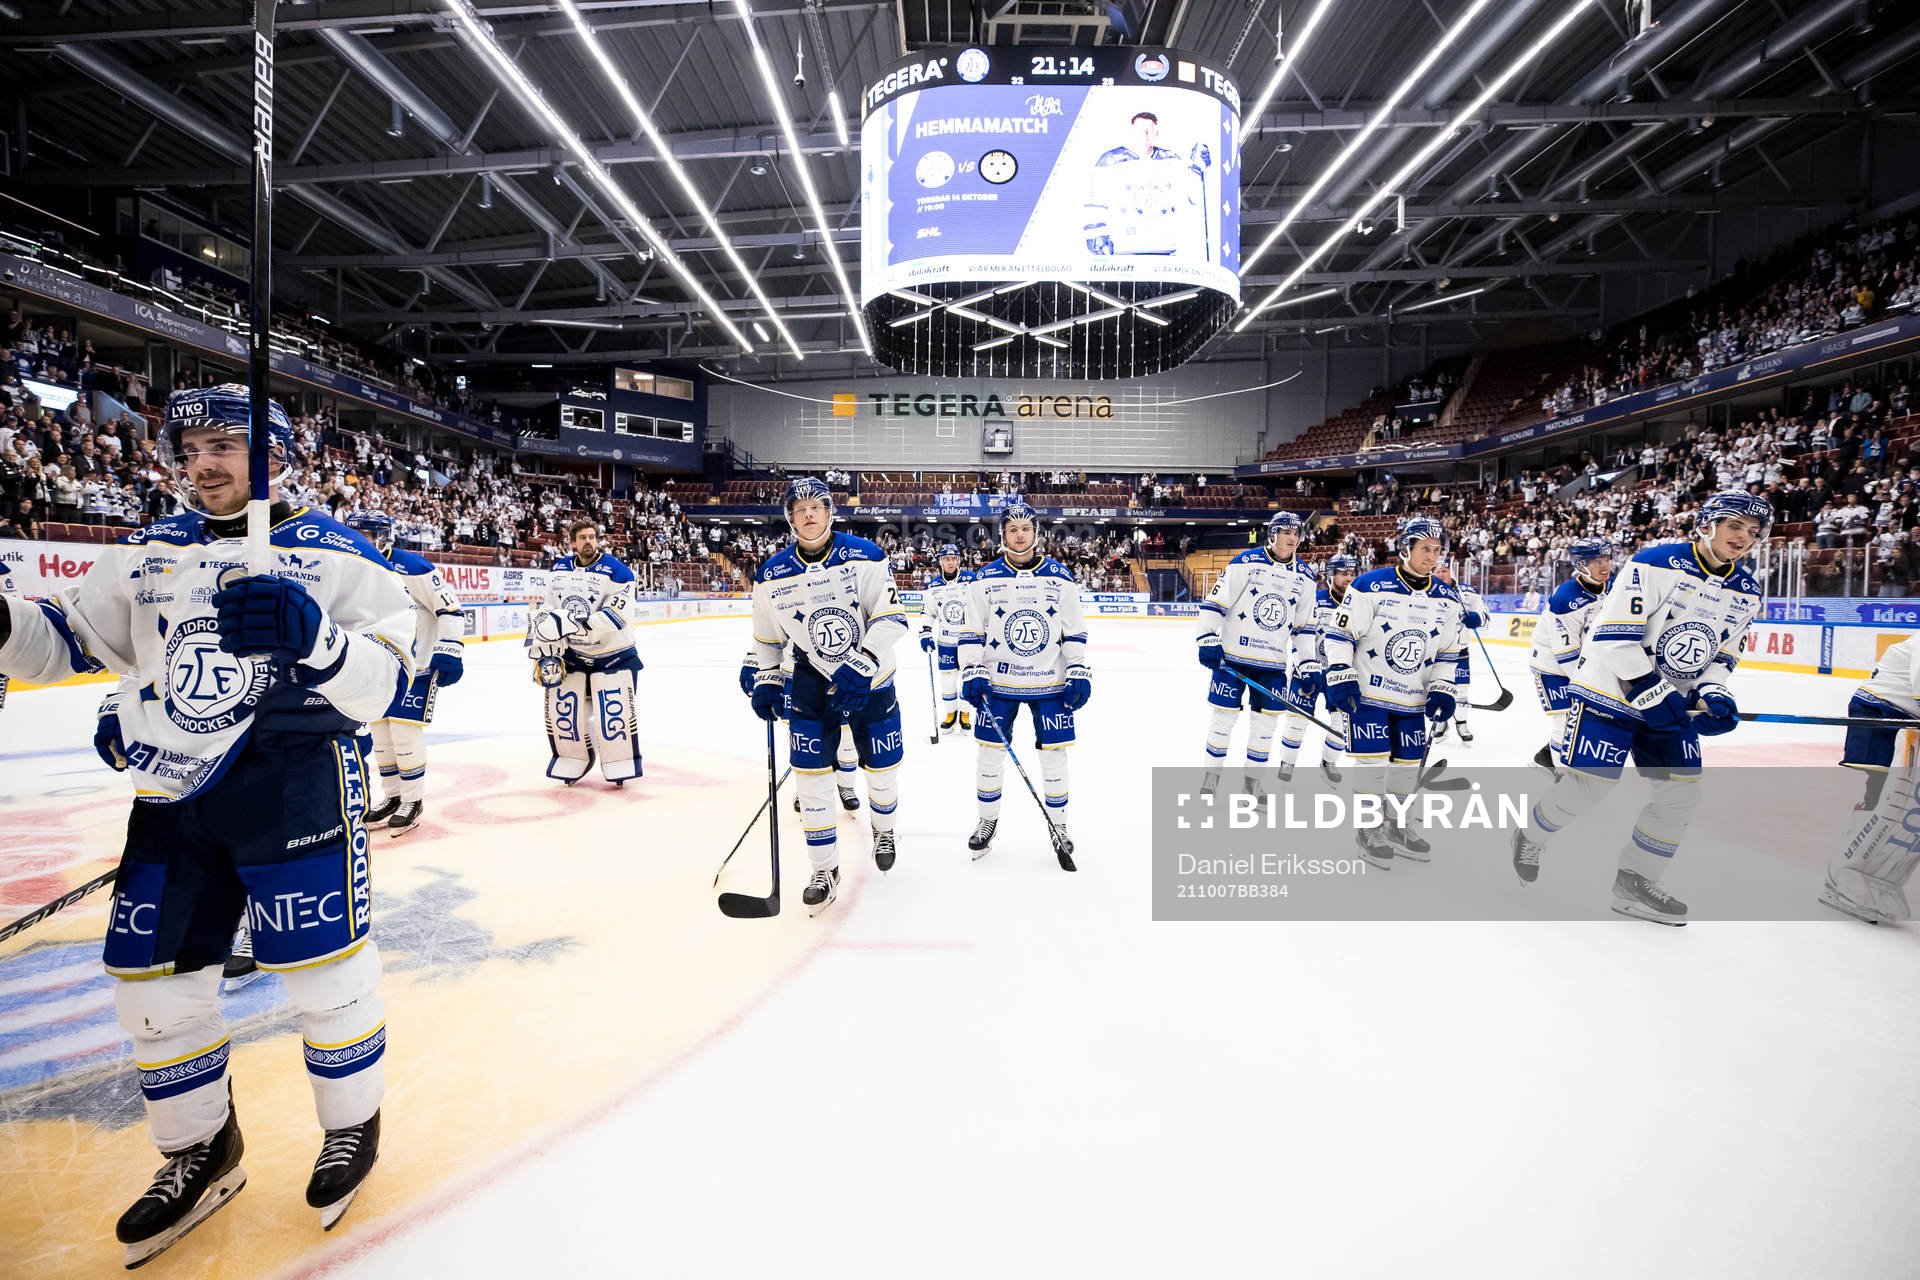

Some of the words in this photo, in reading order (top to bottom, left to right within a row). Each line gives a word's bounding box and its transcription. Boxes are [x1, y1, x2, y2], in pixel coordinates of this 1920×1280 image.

[1032, 57, 1095, 75] 21:14
[916, 117, 1048, 138] HEMMAMATCH
[961, 193, 998, 201] OKTOBER
[908, 264, 950, 277] dalakraft
[1089, 263, 1135, 273] dalakraft
[134, 303, 155, 321] ICA
[172, 403, 204, 418] LYKO
[869, 394, 1006, 417] TEGERA
[1017, 393, 1114, 418] arena
[1545, 414, 1585, 432] MATCHLOGE
[1501, 428, 1534, 443] MATCHLOGE
[854, 507, 870, 515] Falu
[870, 507, 902, 515] Kuriren
[922, 507, 940, 515] clas
[942, 507, 970, 515] ohlson
[1072, 508, 1110, 516] PEAB
[320, 537, 362, 555] Ohlson
[326, 531, 354, 544] Clas
[39, 553, 94, 578] Her
[774, 567, 792, 576] Ohlson
[270, 569, 321, 582] LESANDS
[1212, 585, 1220, 595] 6
[611, 596, 626, 610] 33
[1631, 596, 1643, 615] 6
[1872, 607, 1918, 622] Idre
[1510, 617, 1521, 637] 2
[1561, 634, 1570, 646] 7
[1656, 625, 1686, 657] LEKSANDS
[1738, 636, 1748, 653] 6
[1767, 632, 1795, 655] AB
[1660, 663, 1698, 679] ISHOCKEY
[171, 710, 237, 732] ISHOCKEY
[598, 688, 626, 741] LOGS
[1578, 735, 1627, 764] INTEC
[287, 825, 344, 849] BAUER
[340, 745, 370, 929] RADONETT
[110, 891, 156, 935] TEC
[247, 891, 344, 932] INTEC
